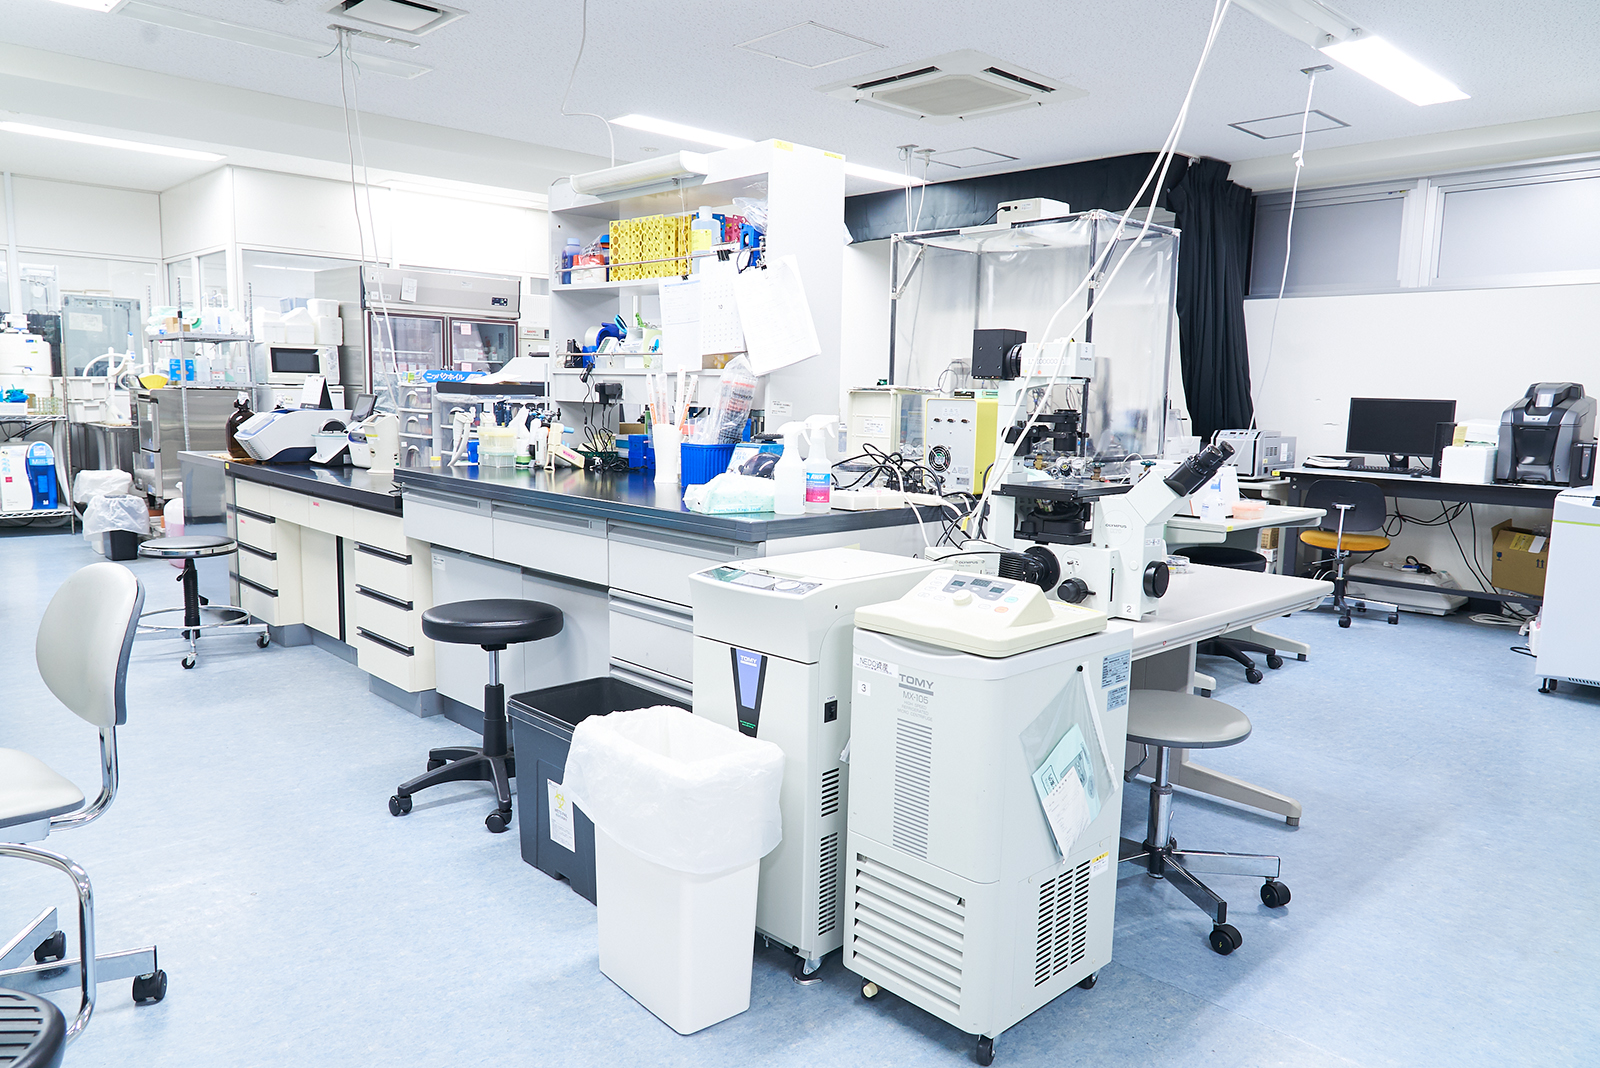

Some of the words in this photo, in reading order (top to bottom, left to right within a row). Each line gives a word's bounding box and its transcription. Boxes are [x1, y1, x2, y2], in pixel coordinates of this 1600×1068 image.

[1126, 605, 1132, 613] 2
[740, 655, 758, 664] TOMY
[898, 673, 935, 690] TOMY
[860, 683, 867, 693] 3
[902, 690, 929, 705] MX-105
